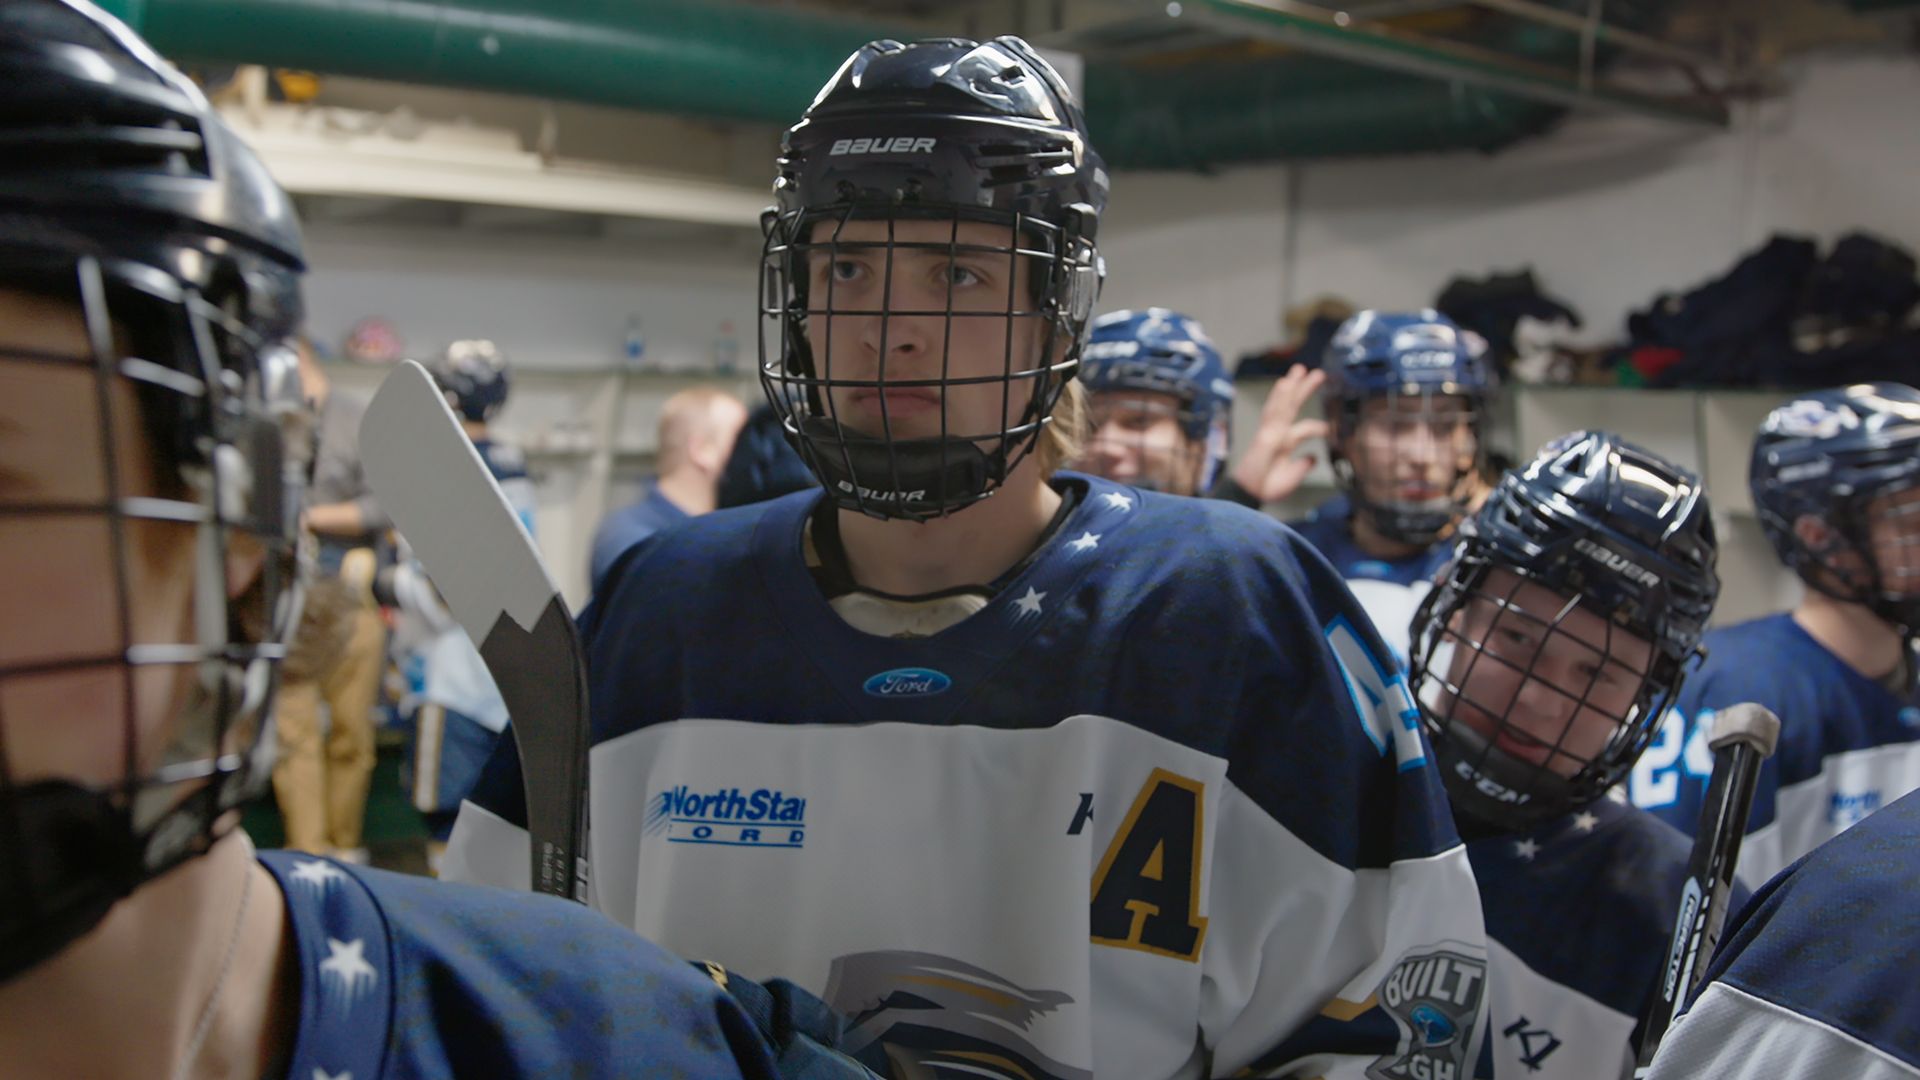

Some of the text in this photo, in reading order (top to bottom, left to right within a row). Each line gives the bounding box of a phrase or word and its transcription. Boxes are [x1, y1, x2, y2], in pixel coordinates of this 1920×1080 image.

[830, 137, 936, 156] BAUER
[1573, 538, 1660, 588] BAUER
[880, 673, 933, 694] Ford
[668, 824, 804, 843] ORD
[1090, 767, 1209, 964] A
[1664, 894, 1696, 1002] REACTOR
[1385, 957, 1482, 1008] BUILT
